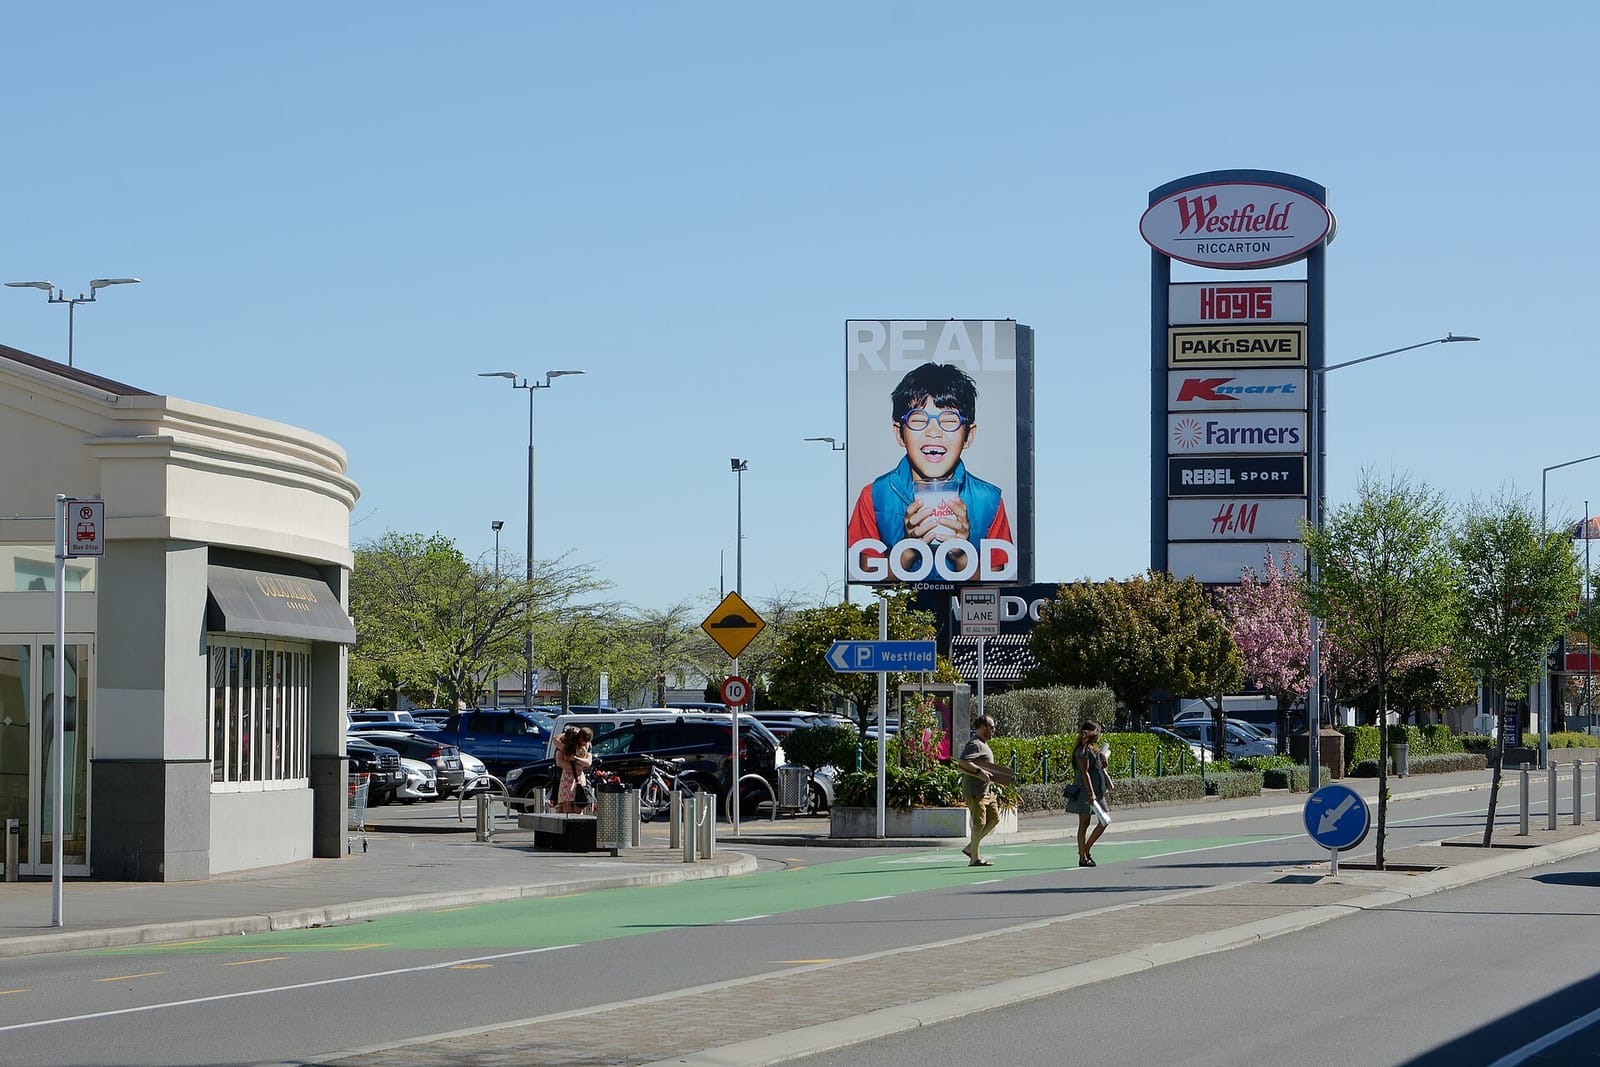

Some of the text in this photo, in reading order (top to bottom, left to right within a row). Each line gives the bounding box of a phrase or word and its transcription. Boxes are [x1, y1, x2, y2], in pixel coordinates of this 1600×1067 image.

[1173, 194, 1294, 234] Westfield
[1197, 242, 1271, 254] RICCARTON
[848, 321, 1016, 371] REAL
[1176, 377, 1297, 402] Kmart
[1206, 421, 1300, 445] Farmers
[1181, 469, 1289, 485] REBEL SPORT
[1211, 503, 1259, 535] H&M
[848, 538, 1017, 581] GOOD
[967, 611, 993, 621] LANE
[857, 647, 932, 666] P Westfield
[729, 685, 742, 697] 10
